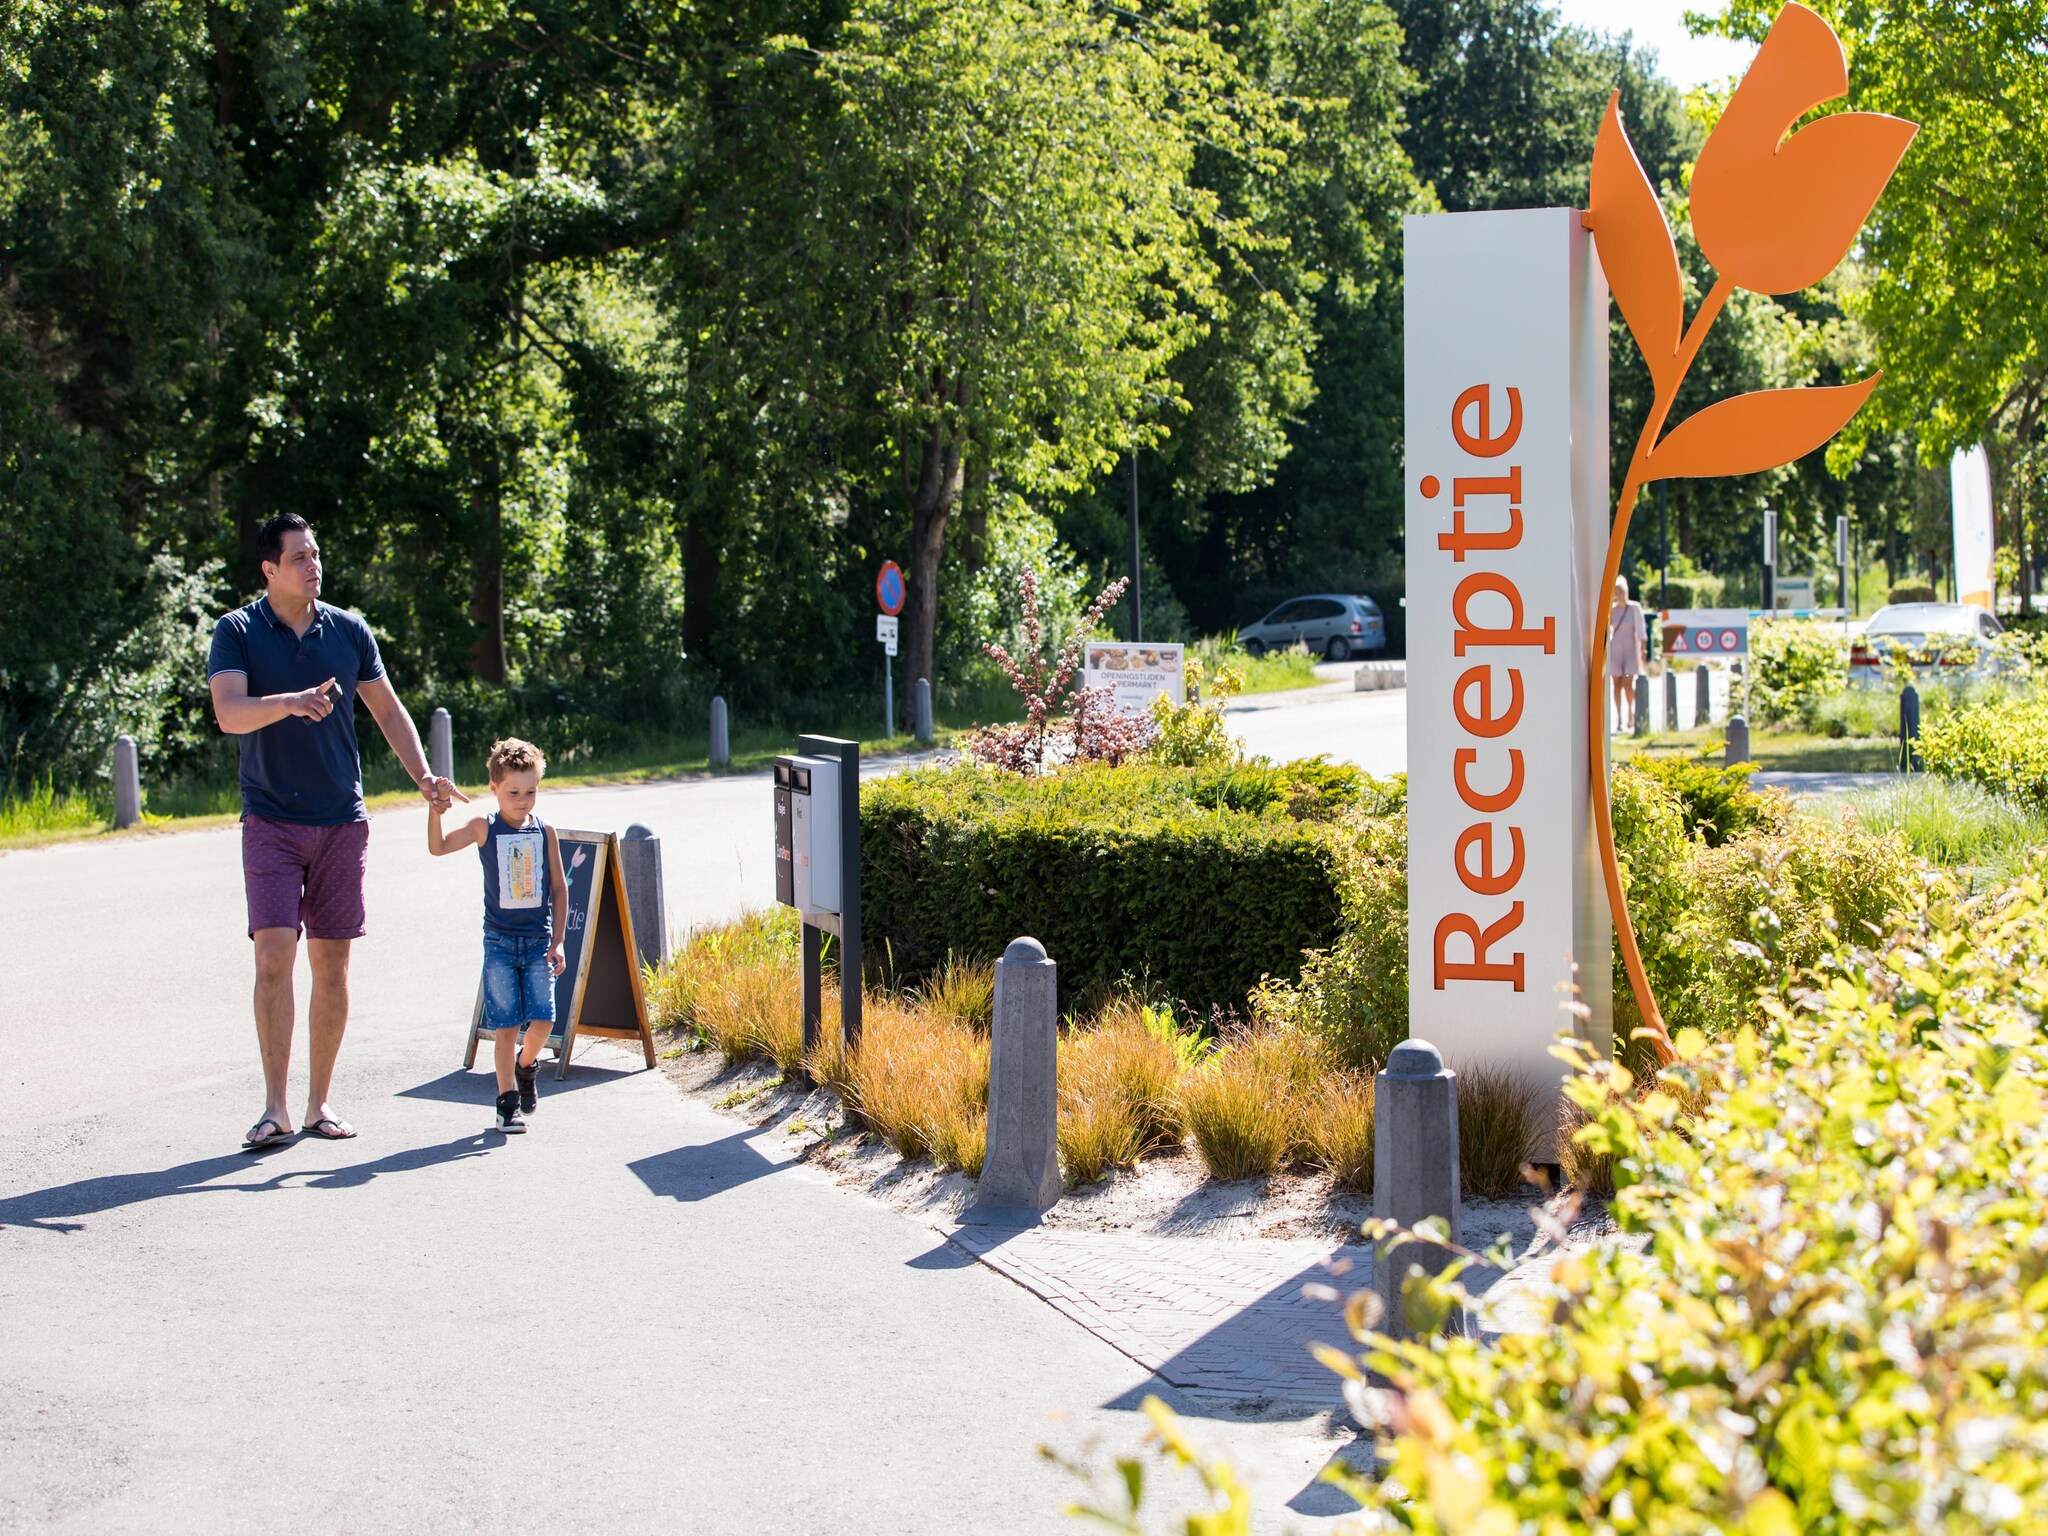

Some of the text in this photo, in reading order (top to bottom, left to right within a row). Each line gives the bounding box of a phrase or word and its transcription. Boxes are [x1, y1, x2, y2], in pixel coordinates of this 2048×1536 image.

[1700, 636, 1710, 646] 15
[1109, 680, 1158, 689] PERMARKT
[1420, 383, 1555, 992] Receptie
[566, 903, 585, 931] tie
